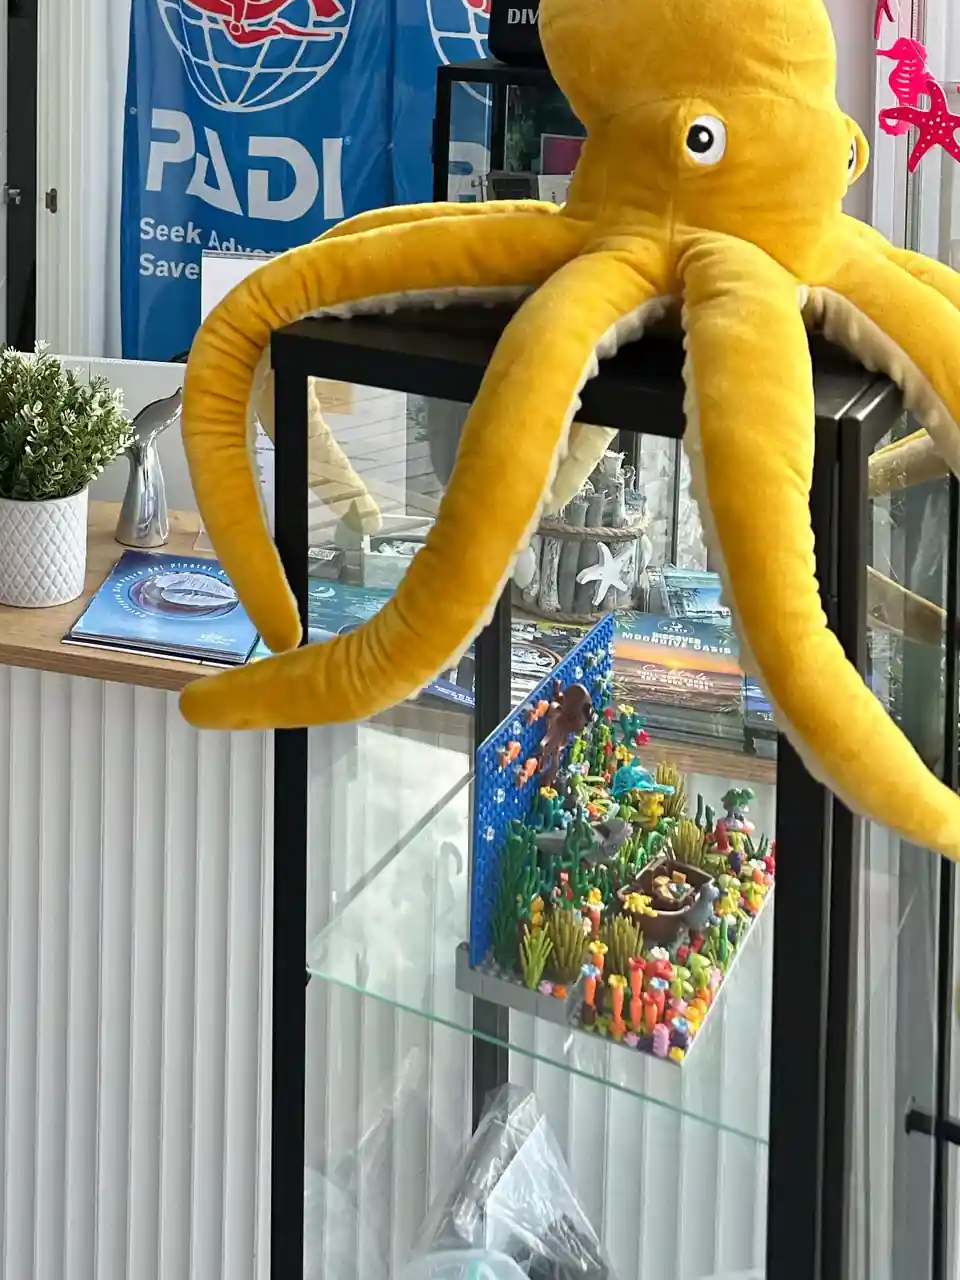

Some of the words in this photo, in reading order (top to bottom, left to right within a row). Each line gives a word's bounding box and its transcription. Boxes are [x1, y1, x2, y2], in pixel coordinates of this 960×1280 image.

[145, 108, 345, 222] PADI
[139, 217, 202, 245] Seek
[139, 253, 200, 280] Save
